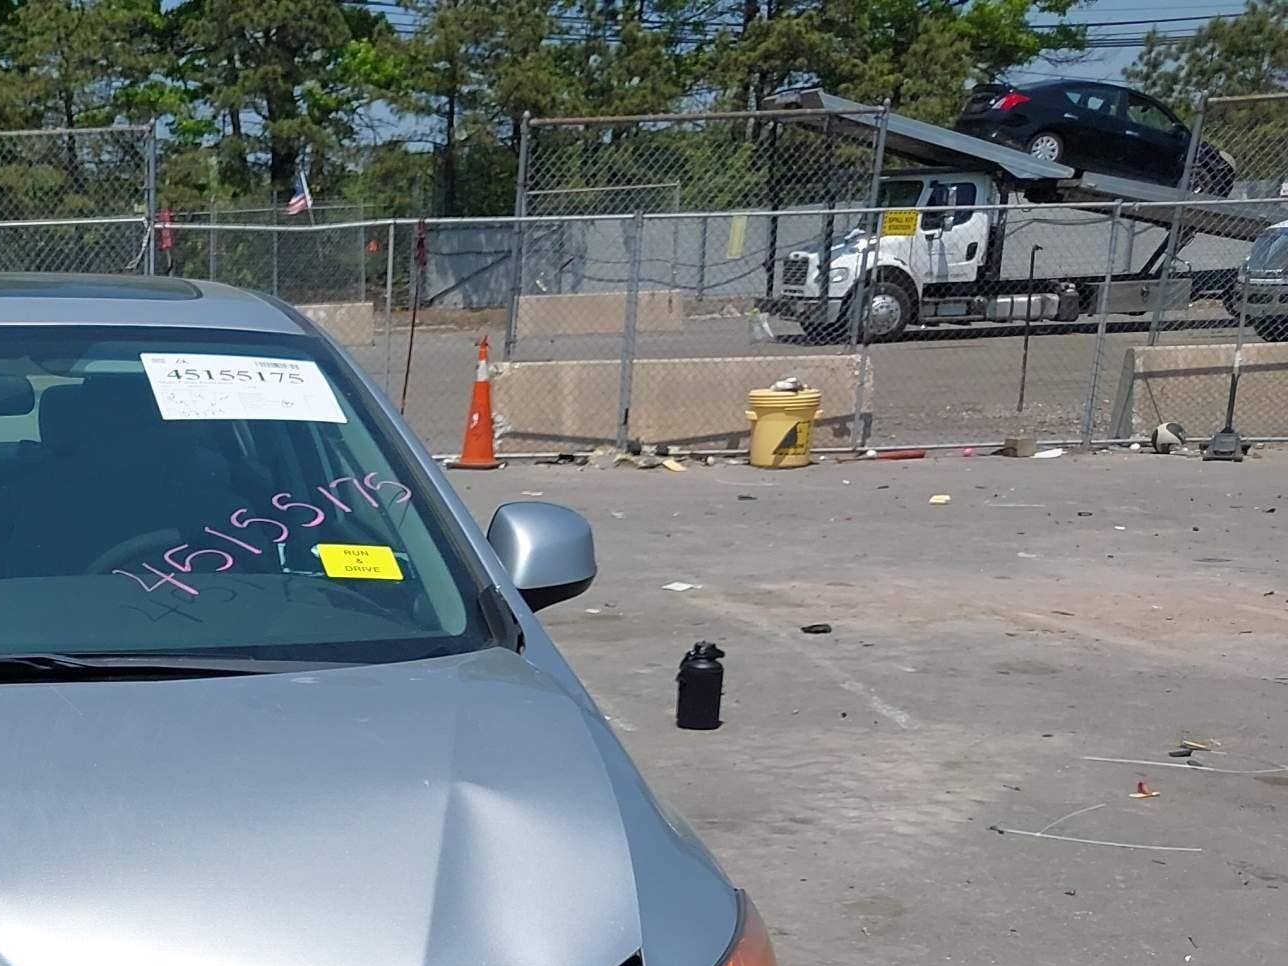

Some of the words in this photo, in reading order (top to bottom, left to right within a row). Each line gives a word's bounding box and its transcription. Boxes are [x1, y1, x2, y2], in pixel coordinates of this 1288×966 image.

[167, 369, 305, 384] 45155175
[112, 472, 412, 595] 45155175
[343, 549, 369, 557] RUN
[344, 565, 383, 573] DRIVE
